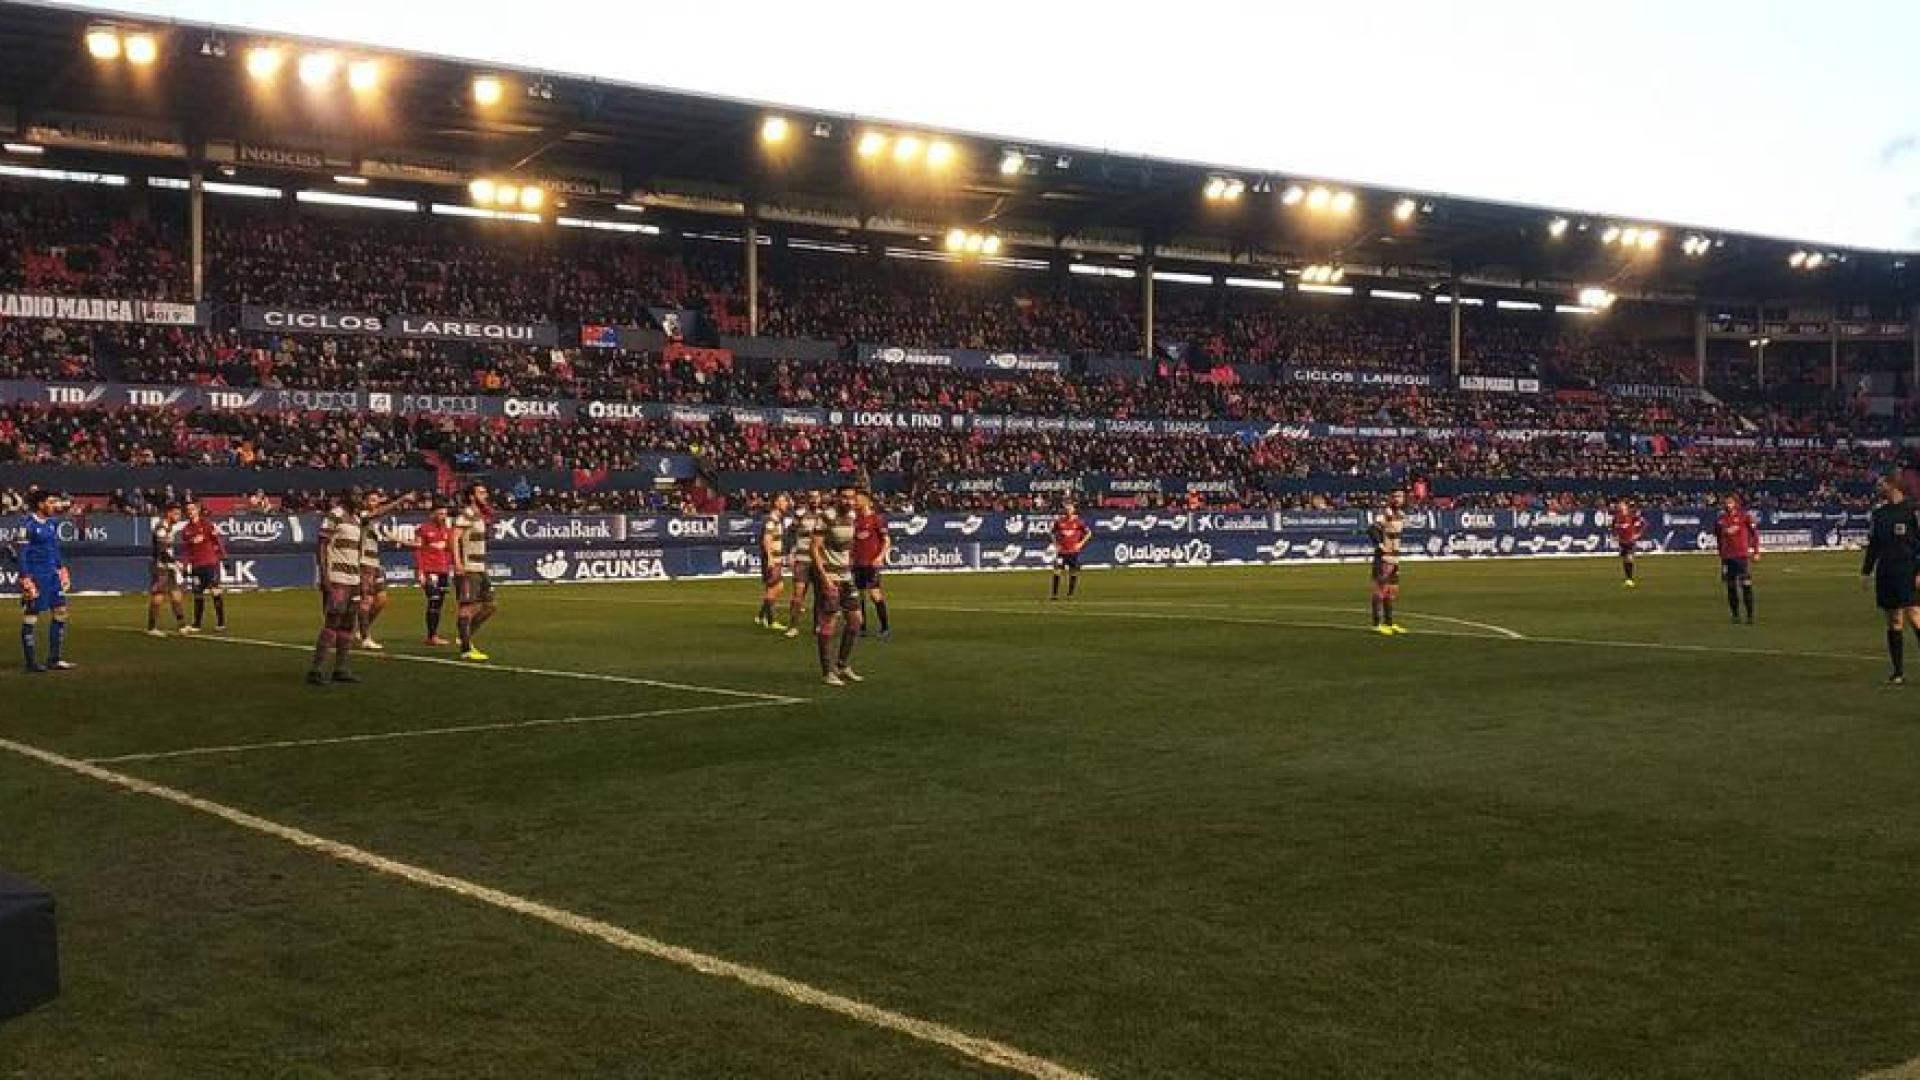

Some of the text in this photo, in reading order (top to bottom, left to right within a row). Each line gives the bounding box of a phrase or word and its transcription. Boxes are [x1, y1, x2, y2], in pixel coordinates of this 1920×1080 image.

[0, 295, 53, 317] ADIO
[56, 297, 134, 322] MARCA
[264, 311, 534, 340] CICLOS LAREQUI
[47, 386, 243, 409] TID TID TID
[853, 411, 943, 428] LOOK & FIND
[520, 518, 612, 539] CaixaBank
[575, 559, 666, 578] ACUNSA
